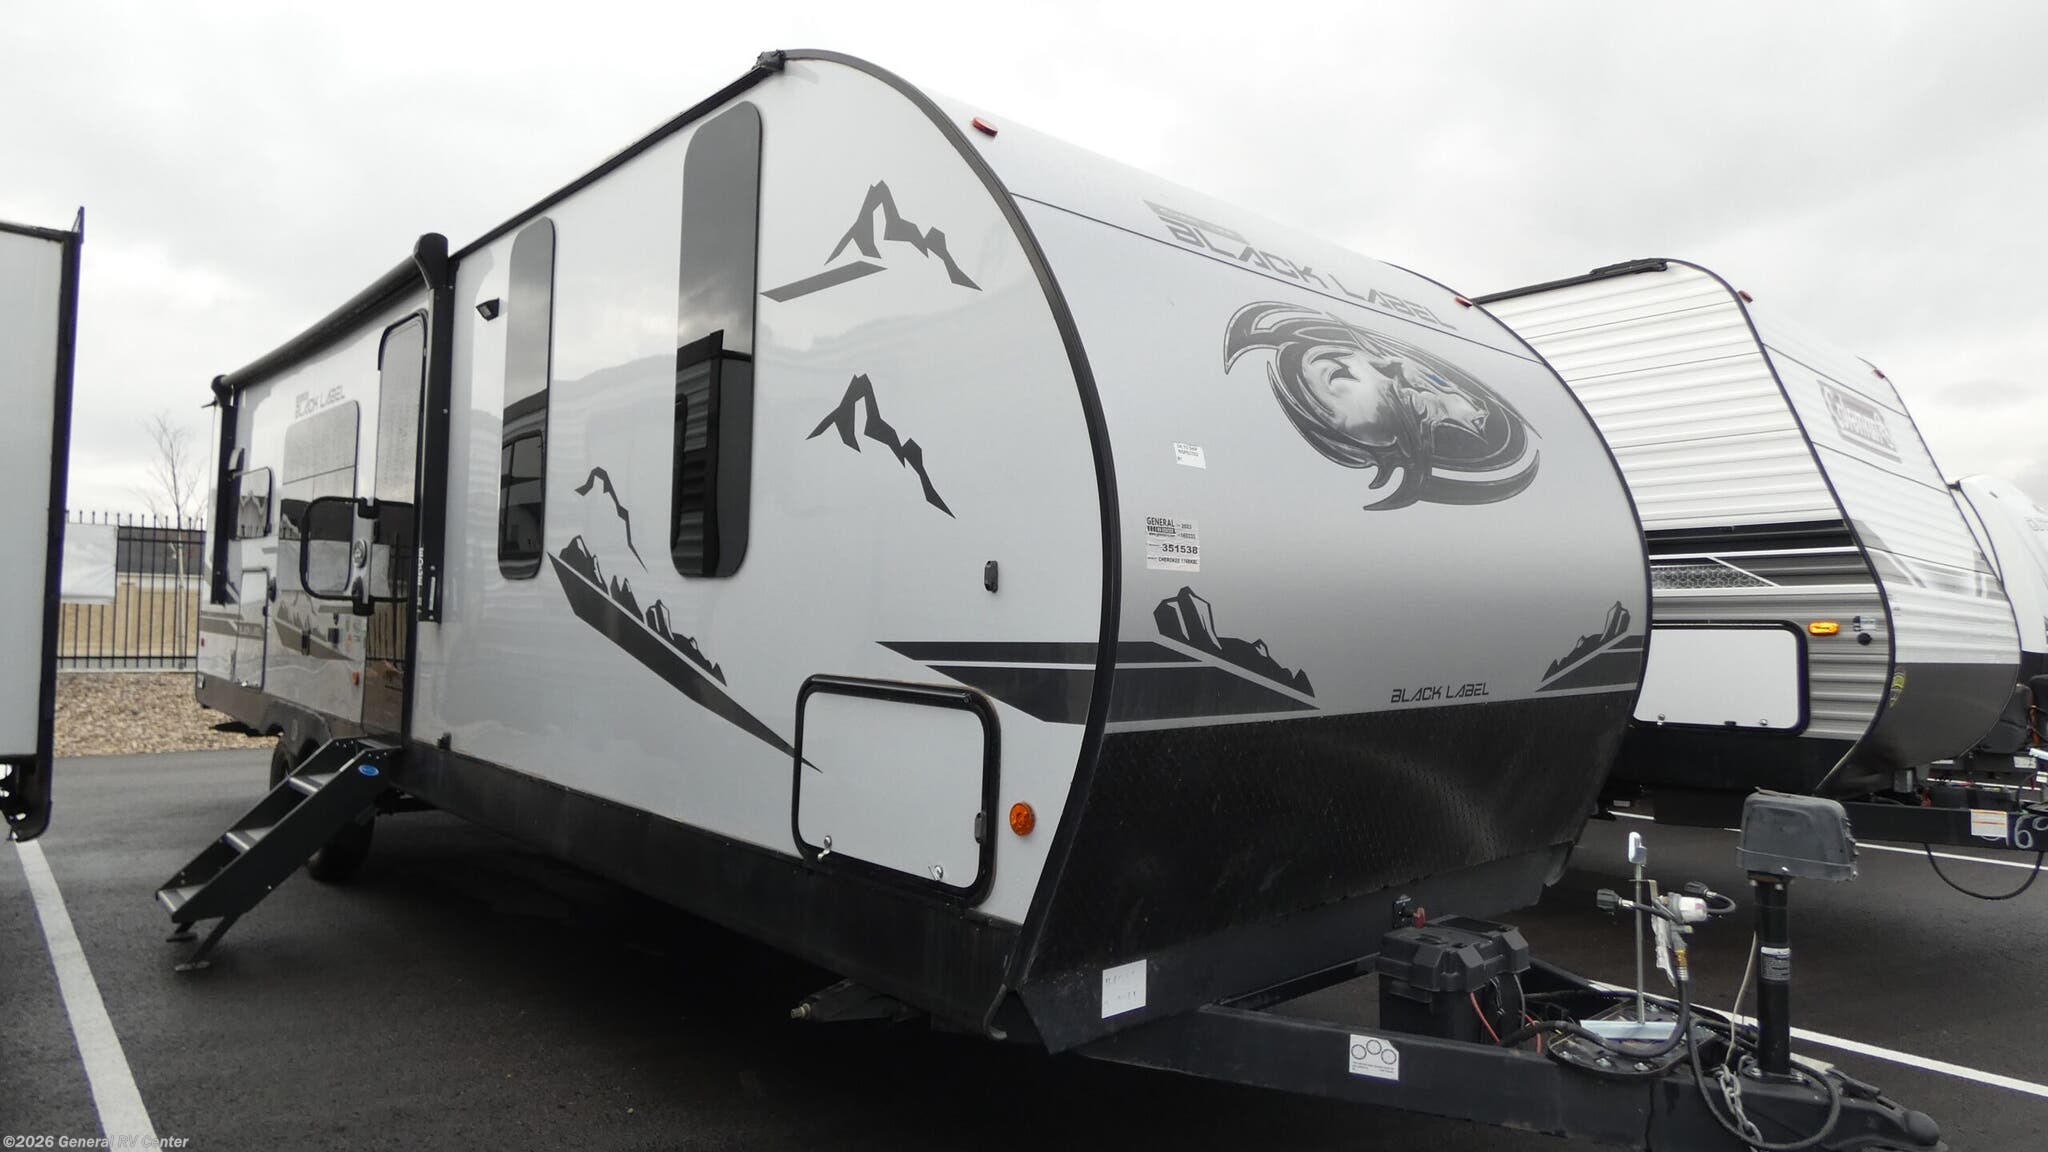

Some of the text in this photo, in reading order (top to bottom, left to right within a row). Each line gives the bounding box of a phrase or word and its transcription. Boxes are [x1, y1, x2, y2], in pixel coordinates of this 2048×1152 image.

[1158, 215, 1329, 290] BLACK
[1328, 272, 1458, 331] LABEL
[1146, 516, 1175, 527] GENERAL
[1162, 543, 1198, 555] 351538
[1390, 682, 1489, 703] BLACK LABEL
